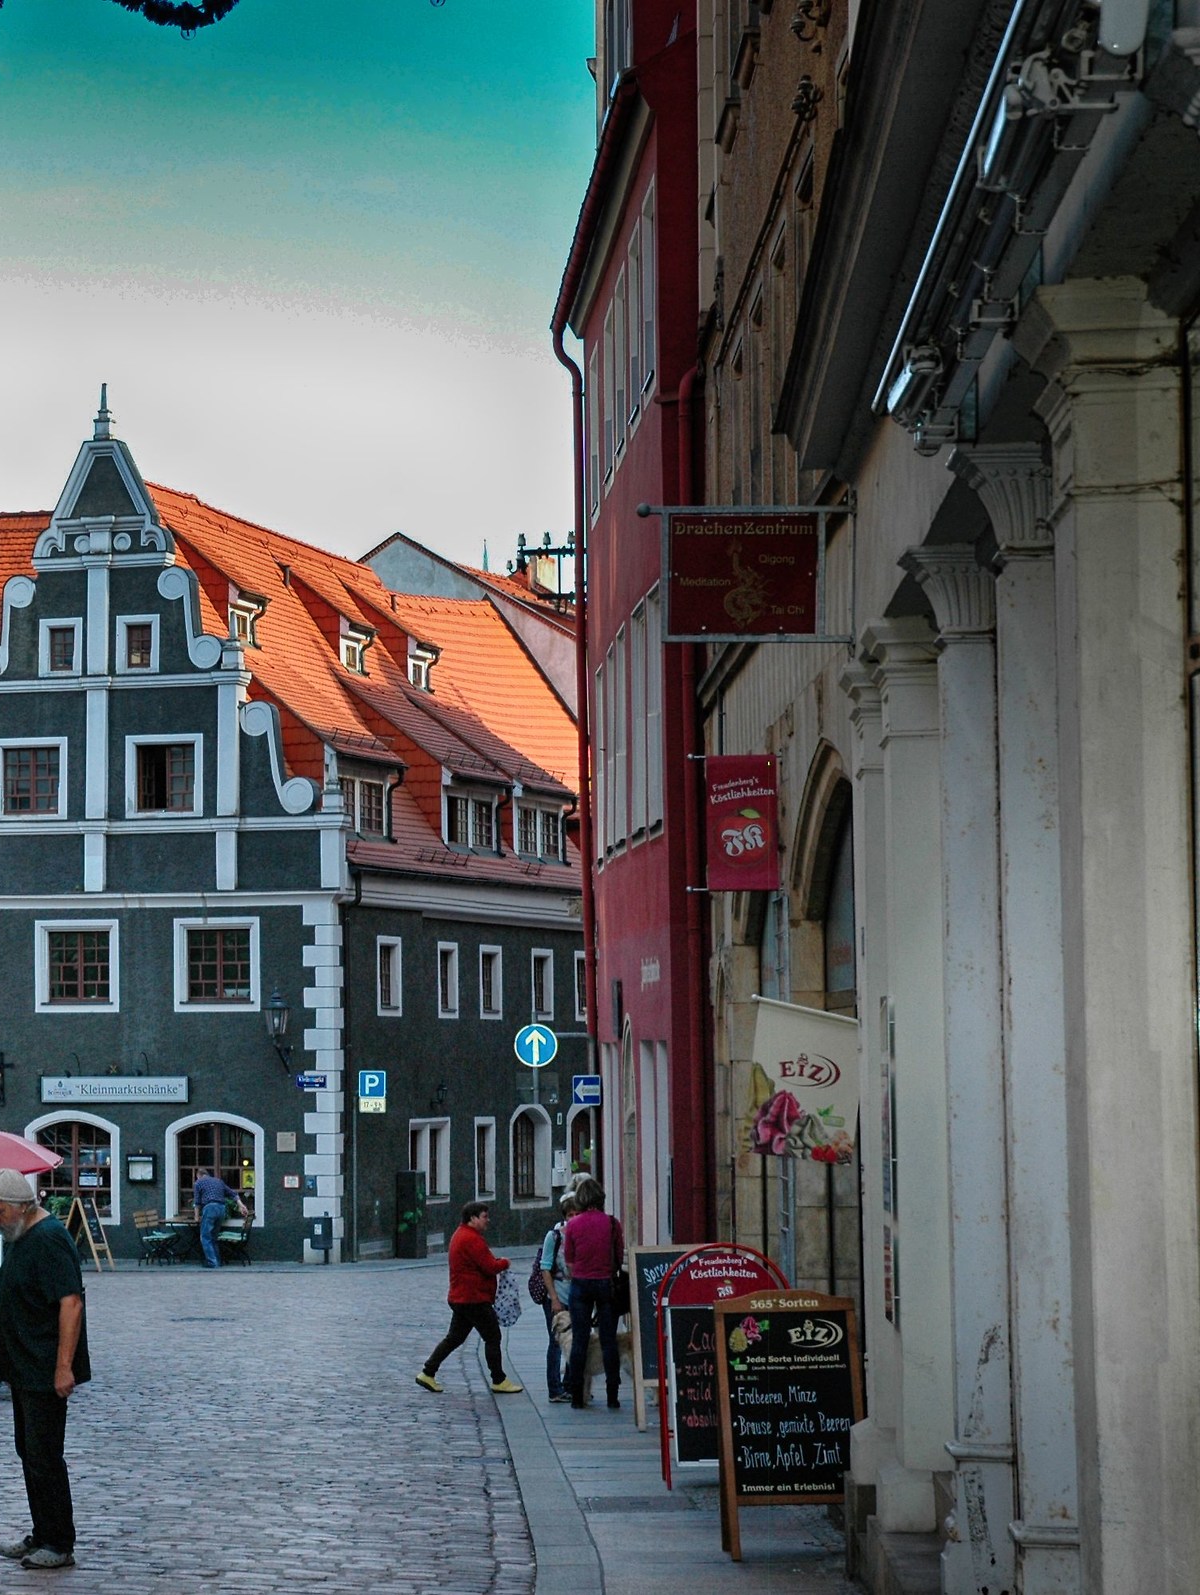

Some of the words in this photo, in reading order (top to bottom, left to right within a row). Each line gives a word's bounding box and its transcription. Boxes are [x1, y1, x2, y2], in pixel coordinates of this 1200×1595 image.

[674, 521, 813, 536] DrachenZentrum
[758, 554, 795, 565] Qigong
[679, 576, 731, 587] Meditation
[771, 605, 785, 615] Tai
[787, 605, 805, 615] Chi
[710, 787, 775, 805] Köstlichkeiten
[365, 1074, 380, 1094] P
[690, 1266, 758, 1280] Köstlichkeiten
[779, 1298, 818, 1308] Sorten
[746, 1355, 766, 1364] Jede
[768, 1355, 792, 1363] Sorte
[794, 1354, 840, 1362] individuell
[687, 1382, 712, 1401] mild
[789, 1385, 817, 1403] Minze
[738, 1415, 772, 1436] Brause
[818, 1411, 850, 1432] Beeren
[776, 1443, 807, 1471] Apfel
[742, 1484, 775, 1492] Immer
[794, 1482, 836, 1491] Erlebnis!
